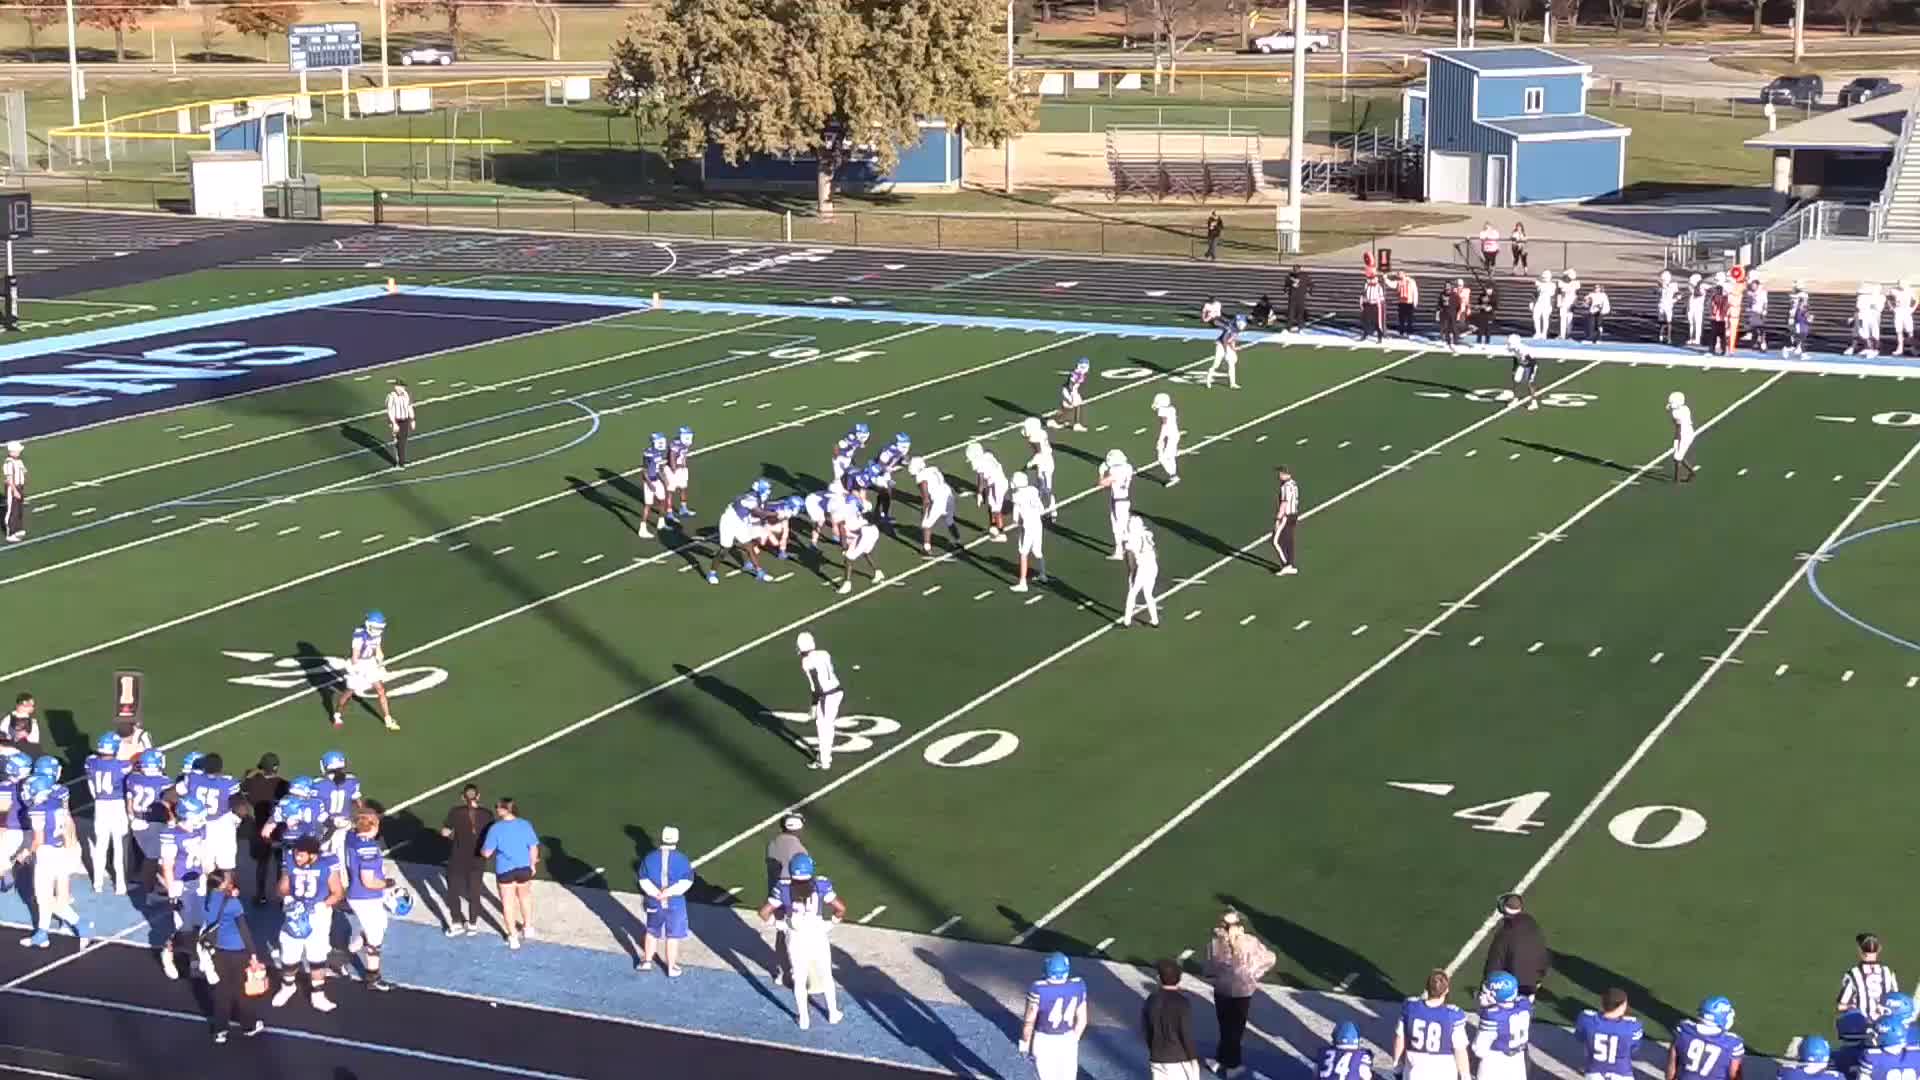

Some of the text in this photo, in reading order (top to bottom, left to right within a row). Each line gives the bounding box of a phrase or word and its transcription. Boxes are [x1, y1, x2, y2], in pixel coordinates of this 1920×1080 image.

[95, 770, 114, 795] 14
[330, 790, 345, 814] 11
[1048, 996, 1079, 1029] 44
[1411, 1017, 1442, 1053] 58
[1593, 1033, 1619, 1064] 51
[1320, 1050, 1352, 1080] 34
[1686, 1038, 1721, 1076] 97
